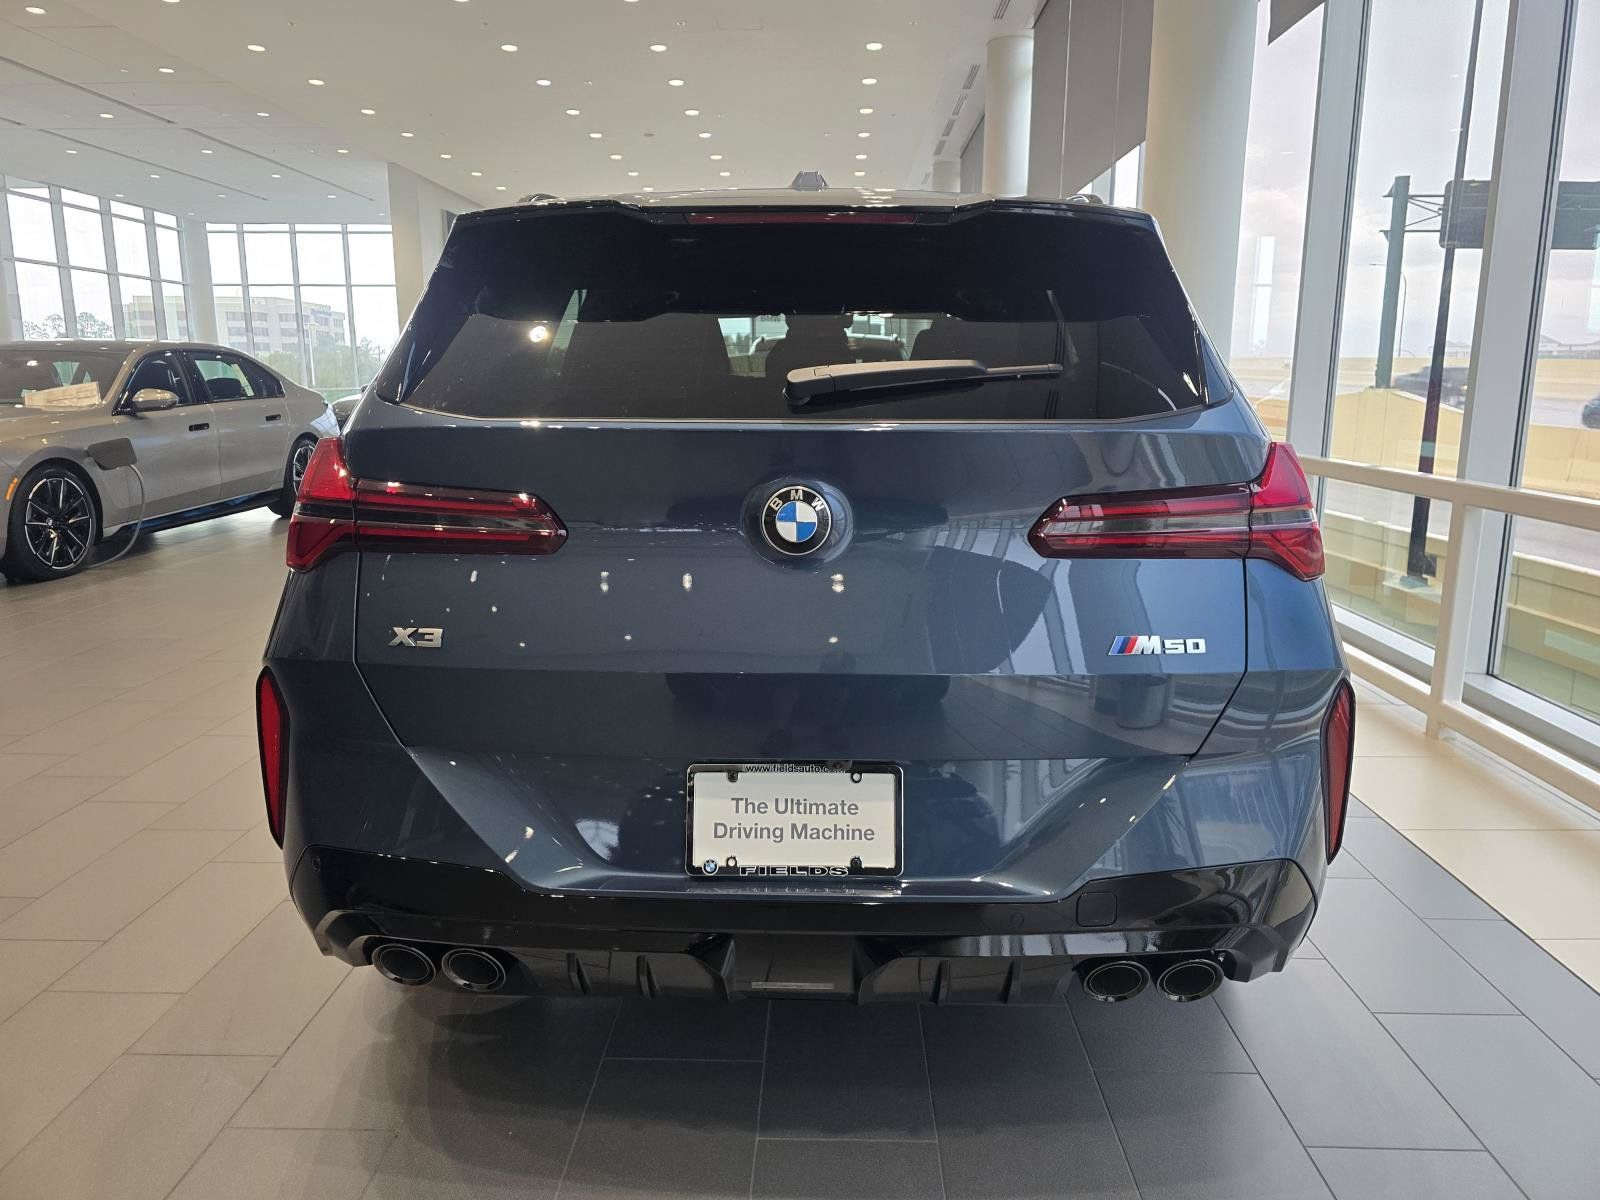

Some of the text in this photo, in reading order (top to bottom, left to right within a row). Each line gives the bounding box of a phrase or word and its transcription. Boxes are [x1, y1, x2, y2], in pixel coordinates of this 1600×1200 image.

[769, 489, 825, 512] BMW
[388, 626, 444, 648] X3
[1131, 635, 1206, 655] M50
[745, 763, 846, 773] www.fieldsauto.c
[731, 797, 860, 816] The Ultimate
[713, 822, 876, 843] Driving Machine
[739, 864, 849, 877] FIELDS
